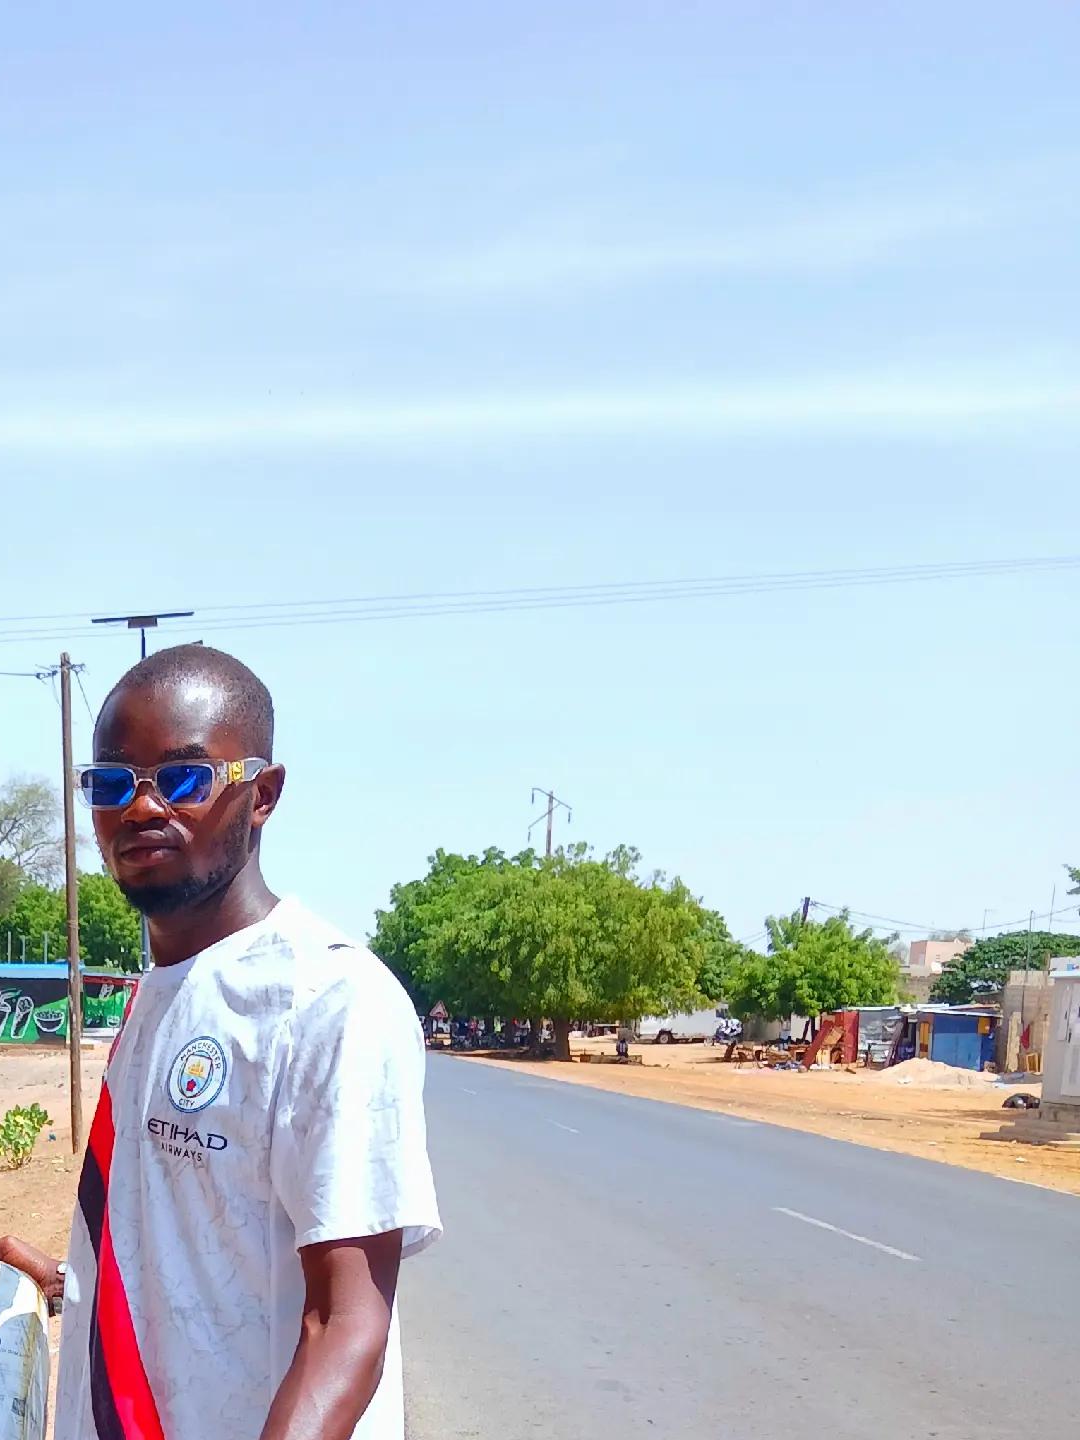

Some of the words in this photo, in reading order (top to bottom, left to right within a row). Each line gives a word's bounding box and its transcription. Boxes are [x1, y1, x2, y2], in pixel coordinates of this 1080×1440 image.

[180, 1042, 221, 1070] MANCHESTER
[178, 1098, 195, 1108] CITY
[147, 1118, 228, 1151] ETIHAD
[161, 1142, 203, 1162] AIRWAYS
